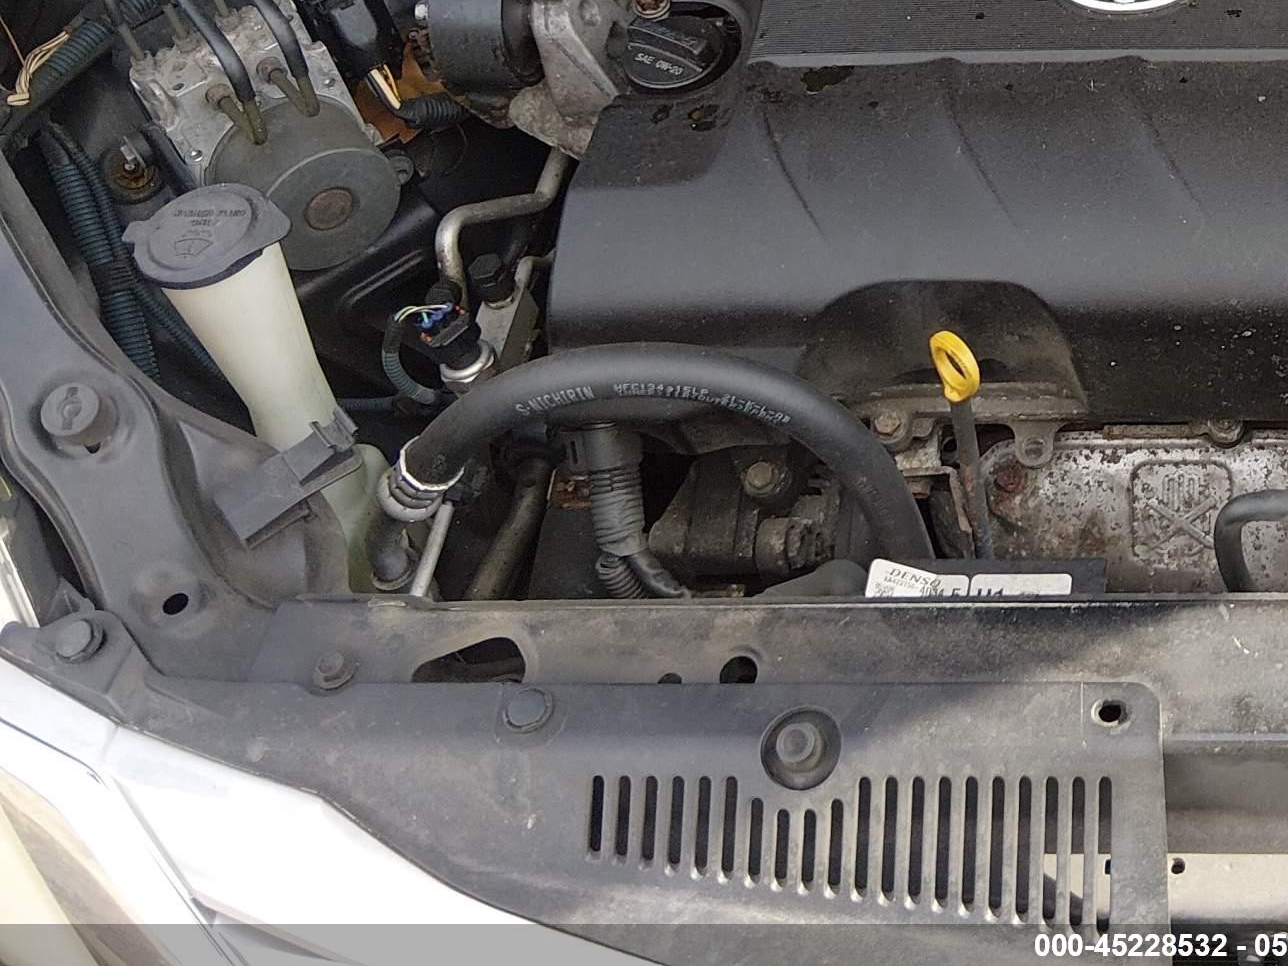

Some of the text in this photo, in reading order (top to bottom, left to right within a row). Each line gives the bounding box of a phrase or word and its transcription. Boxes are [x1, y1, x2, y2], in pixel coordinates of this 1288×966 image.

[635, 52, 684, 75] SAE 0W-20
[889, 568, 941, 587] DENSO
